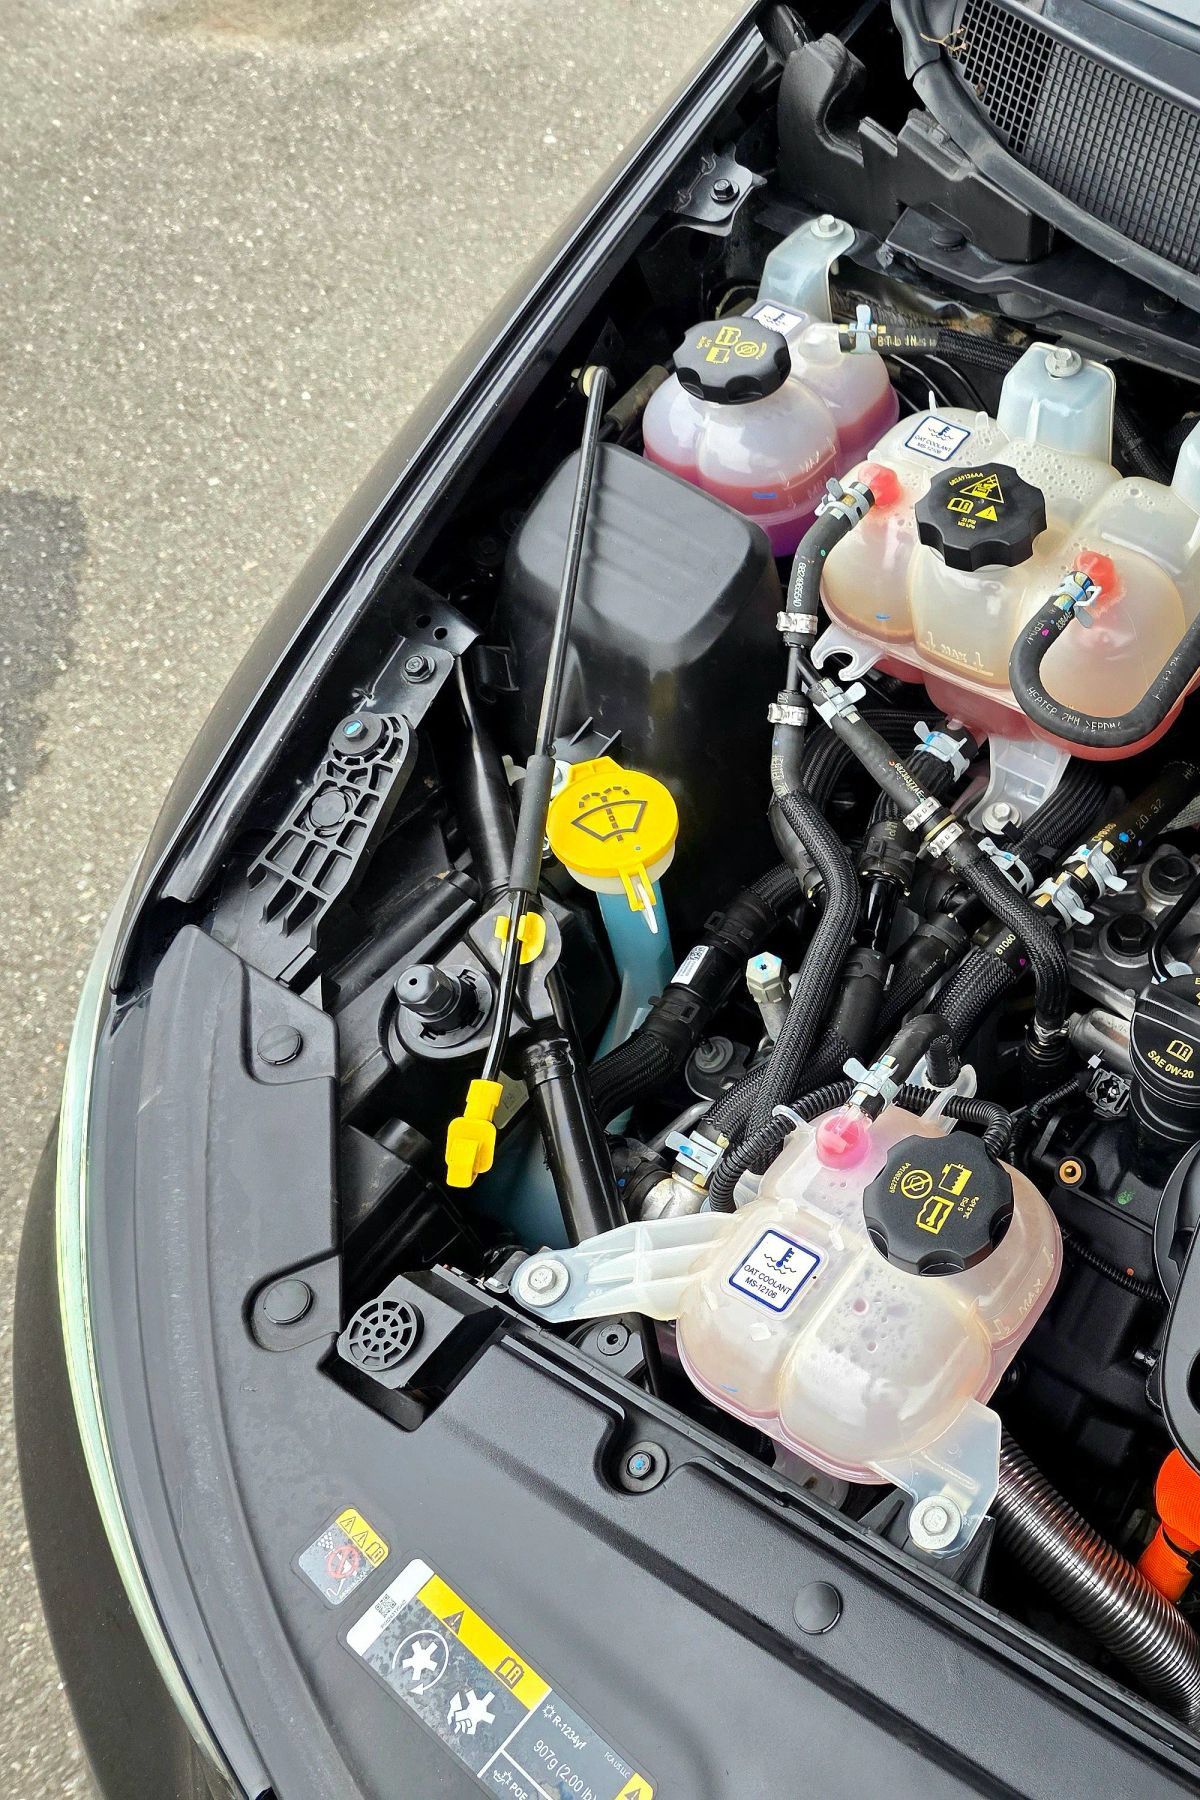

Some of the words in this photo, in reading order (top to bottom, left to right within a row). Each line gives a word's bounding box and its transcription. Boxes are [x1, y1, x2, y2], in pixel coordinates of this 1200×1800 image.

[995, 933, 1016, 955] 81060
[1147, 1050, 1167, 1068] SAE
[1165, 1064, 1195, 1079] 0W-20
[744, 1264, 760, 1276] OAT
[758, 1272, 792, 1295] COOLANT
[744, 1277, 778, 1299] MS-12106
[552, 1715, 588, 1750] R-1234yf
[533, 1740, 559, 1770] 907g
[556, 1760, 584, 1792] (2.00
[604, 1751, 615, 1765] FCA
[613, 1761, 623, 1771] US
[620, 1766, 631, 1779] LLC
[509, 1781, 529, 1800] POE
